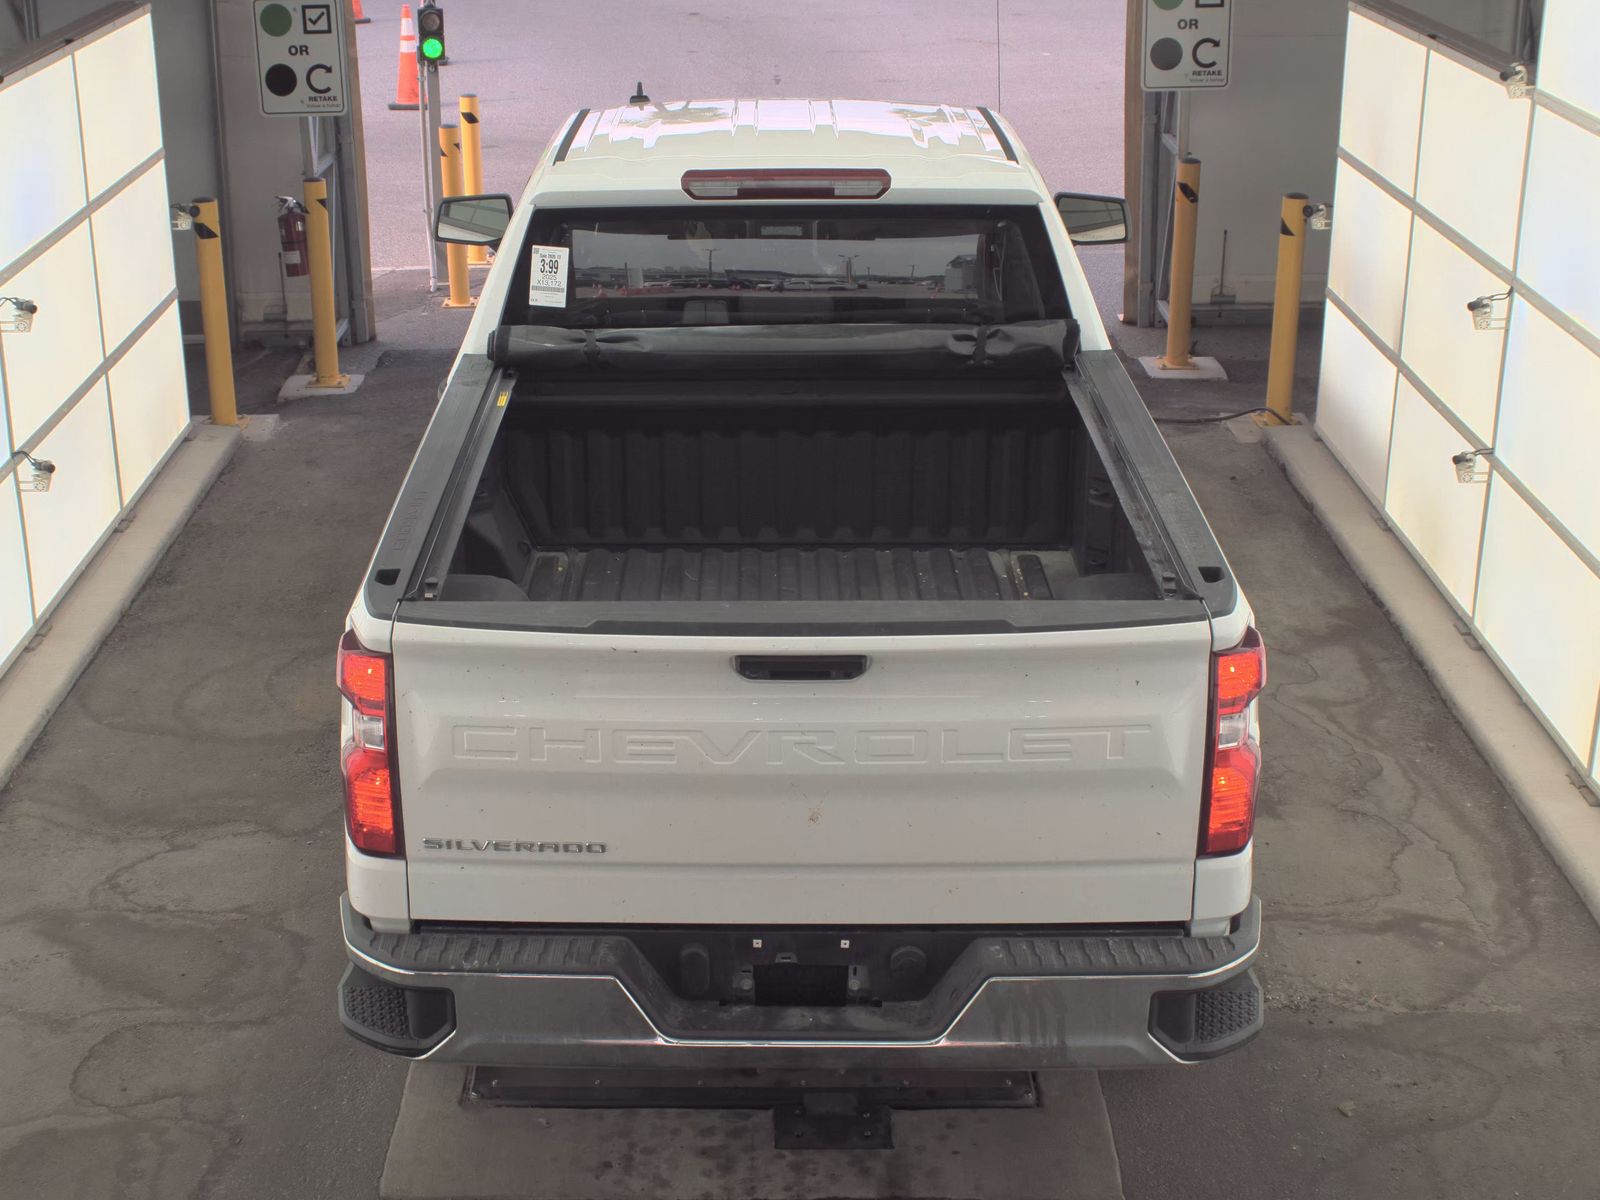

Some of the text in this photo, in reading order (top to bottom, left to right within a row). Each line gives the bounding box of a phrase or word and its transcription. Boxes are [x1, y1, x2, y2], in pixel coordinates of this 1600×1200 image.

[1177, 18, 1199, 30] OR
[288, 45, 310, 56] OR
[452, 724, 1152, 765] CHEVROLET
[423, 837, 607, 854] SILVERADO
